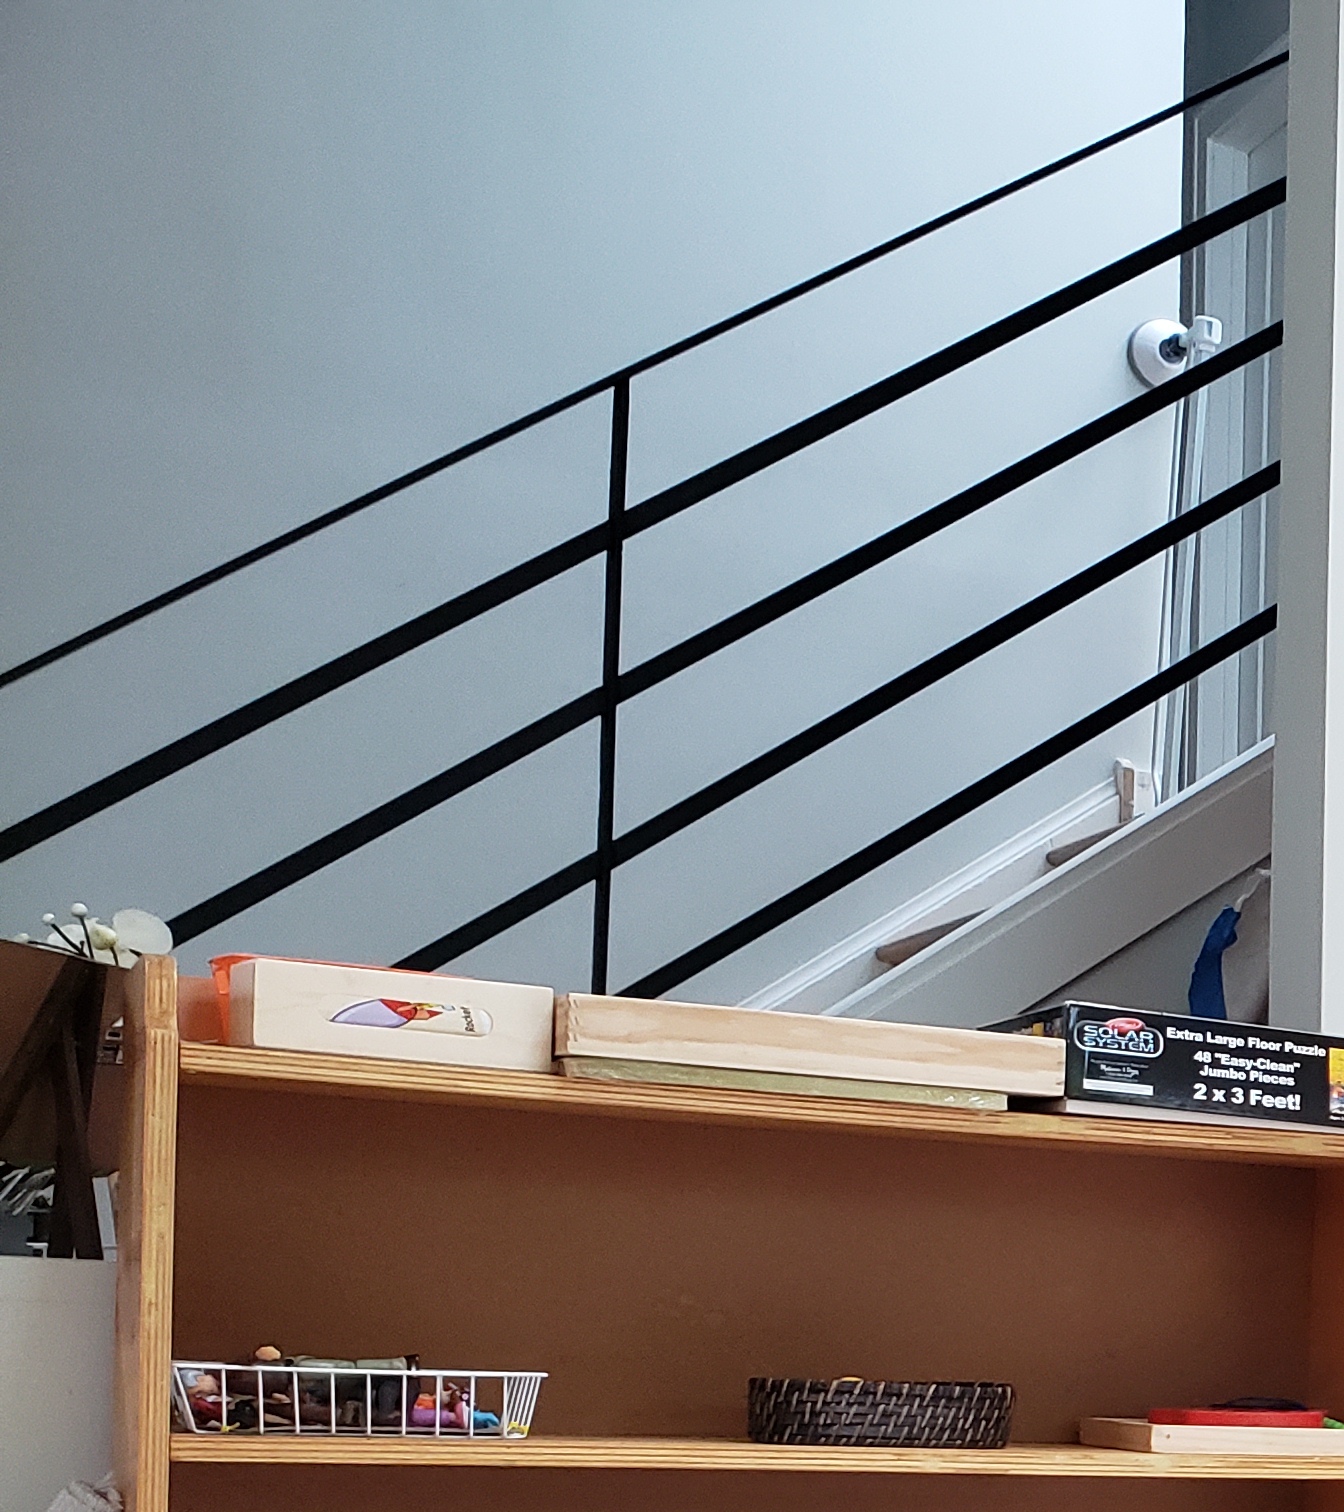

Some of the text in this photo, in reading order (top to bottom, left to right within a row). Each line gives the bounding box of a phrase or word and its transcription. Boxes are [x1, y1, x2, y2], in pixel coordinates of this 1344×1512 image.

[460, 1006, 476, 1032] Rocket
[1083, 1025, 1154, 1044] SOLAR
[1083, 1036, 1154, 1052] SYSTEM
[1166, 1026, 1327, 1057] Extra Large Floor Puzzle
[1193, 1050, 1301, 1073] 48 "Easy-Clean"
[1199, 1065, 1296, 1086] Jumbo Pieces
[1193, 1083, 1302, 1111] 2 x 3 Feet!
